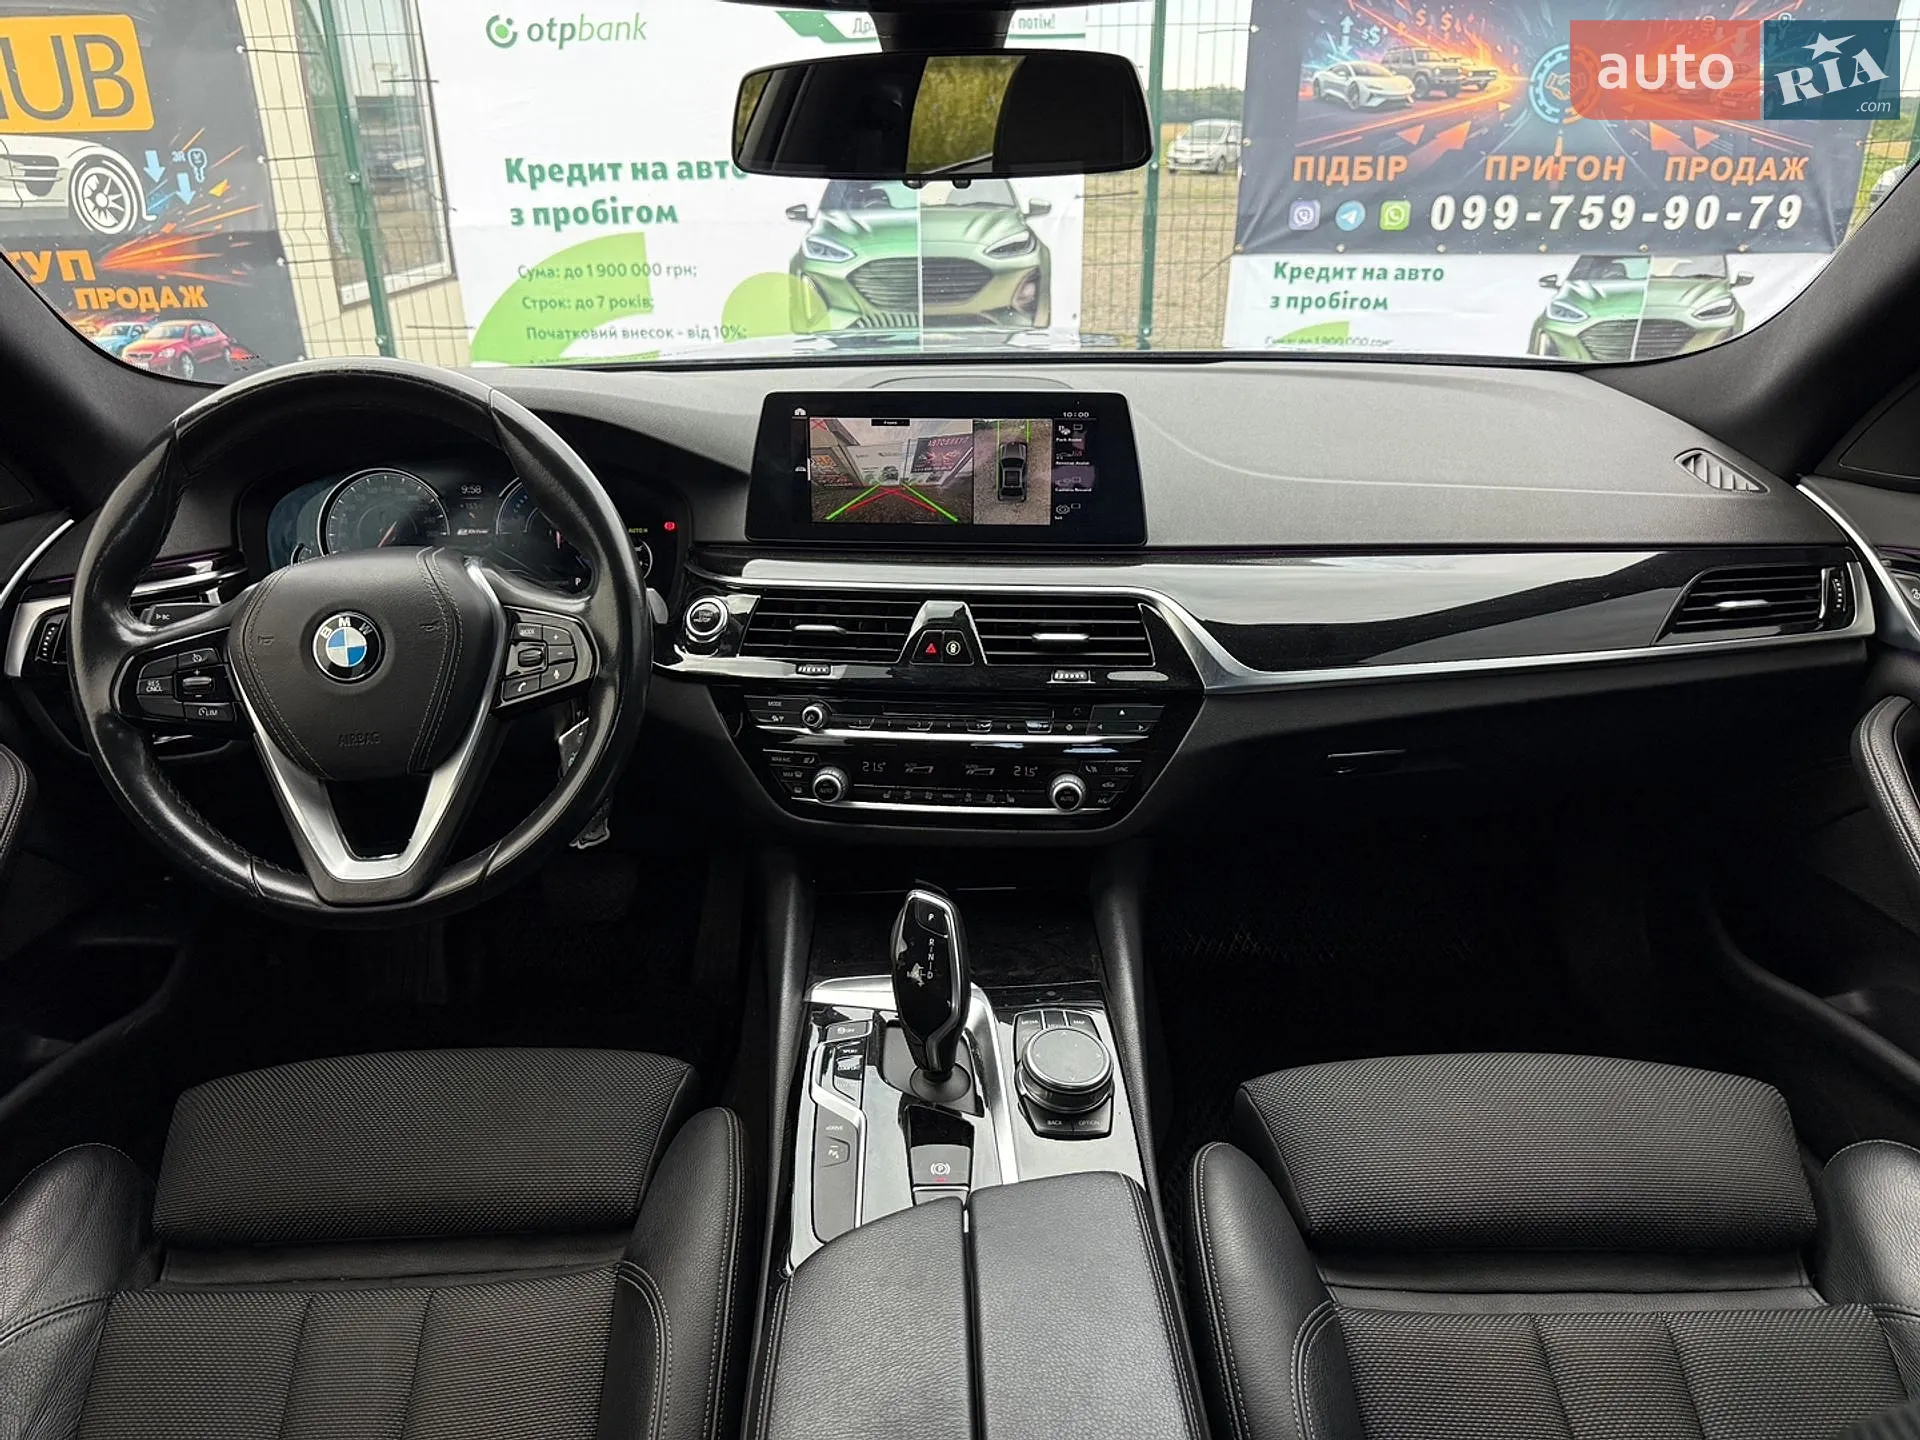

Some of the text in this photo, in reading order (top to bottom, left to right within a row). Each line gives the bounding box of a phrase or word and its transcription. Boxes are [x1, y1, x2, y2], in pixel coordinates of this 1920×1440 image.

[527, 13, 648, 49] otpbank
[504, 158, 623, 190] Кредит
[631, 161, 668, 181] на
[1293, 155, 1809, 186] ПІДБІР ПРИГОН ПРОДАЖ
[510, 196, 679, 232] з пробігом
[1430, 194, 1803, 231] 099-759-90-79
[518, 264, 560, 281] Сума:
[564, 265, 584, 280] до
[1273, 262, 1445, 284] Кредит на авто
[74, 285, 208, 313] ПРОДАЖ
[522, 295, 571, 314] Строк:
[575, 298, 594, 312] до
[598, 296, 606, 309] 7
[1270, 290, 1389, 314] з пробігом
[526, 325, 618, 341] Початковий
[621, 329, 674, 339] внесок
[460, 484, 483, 495] 9:58
[320, 616, 373, 639] BMW
